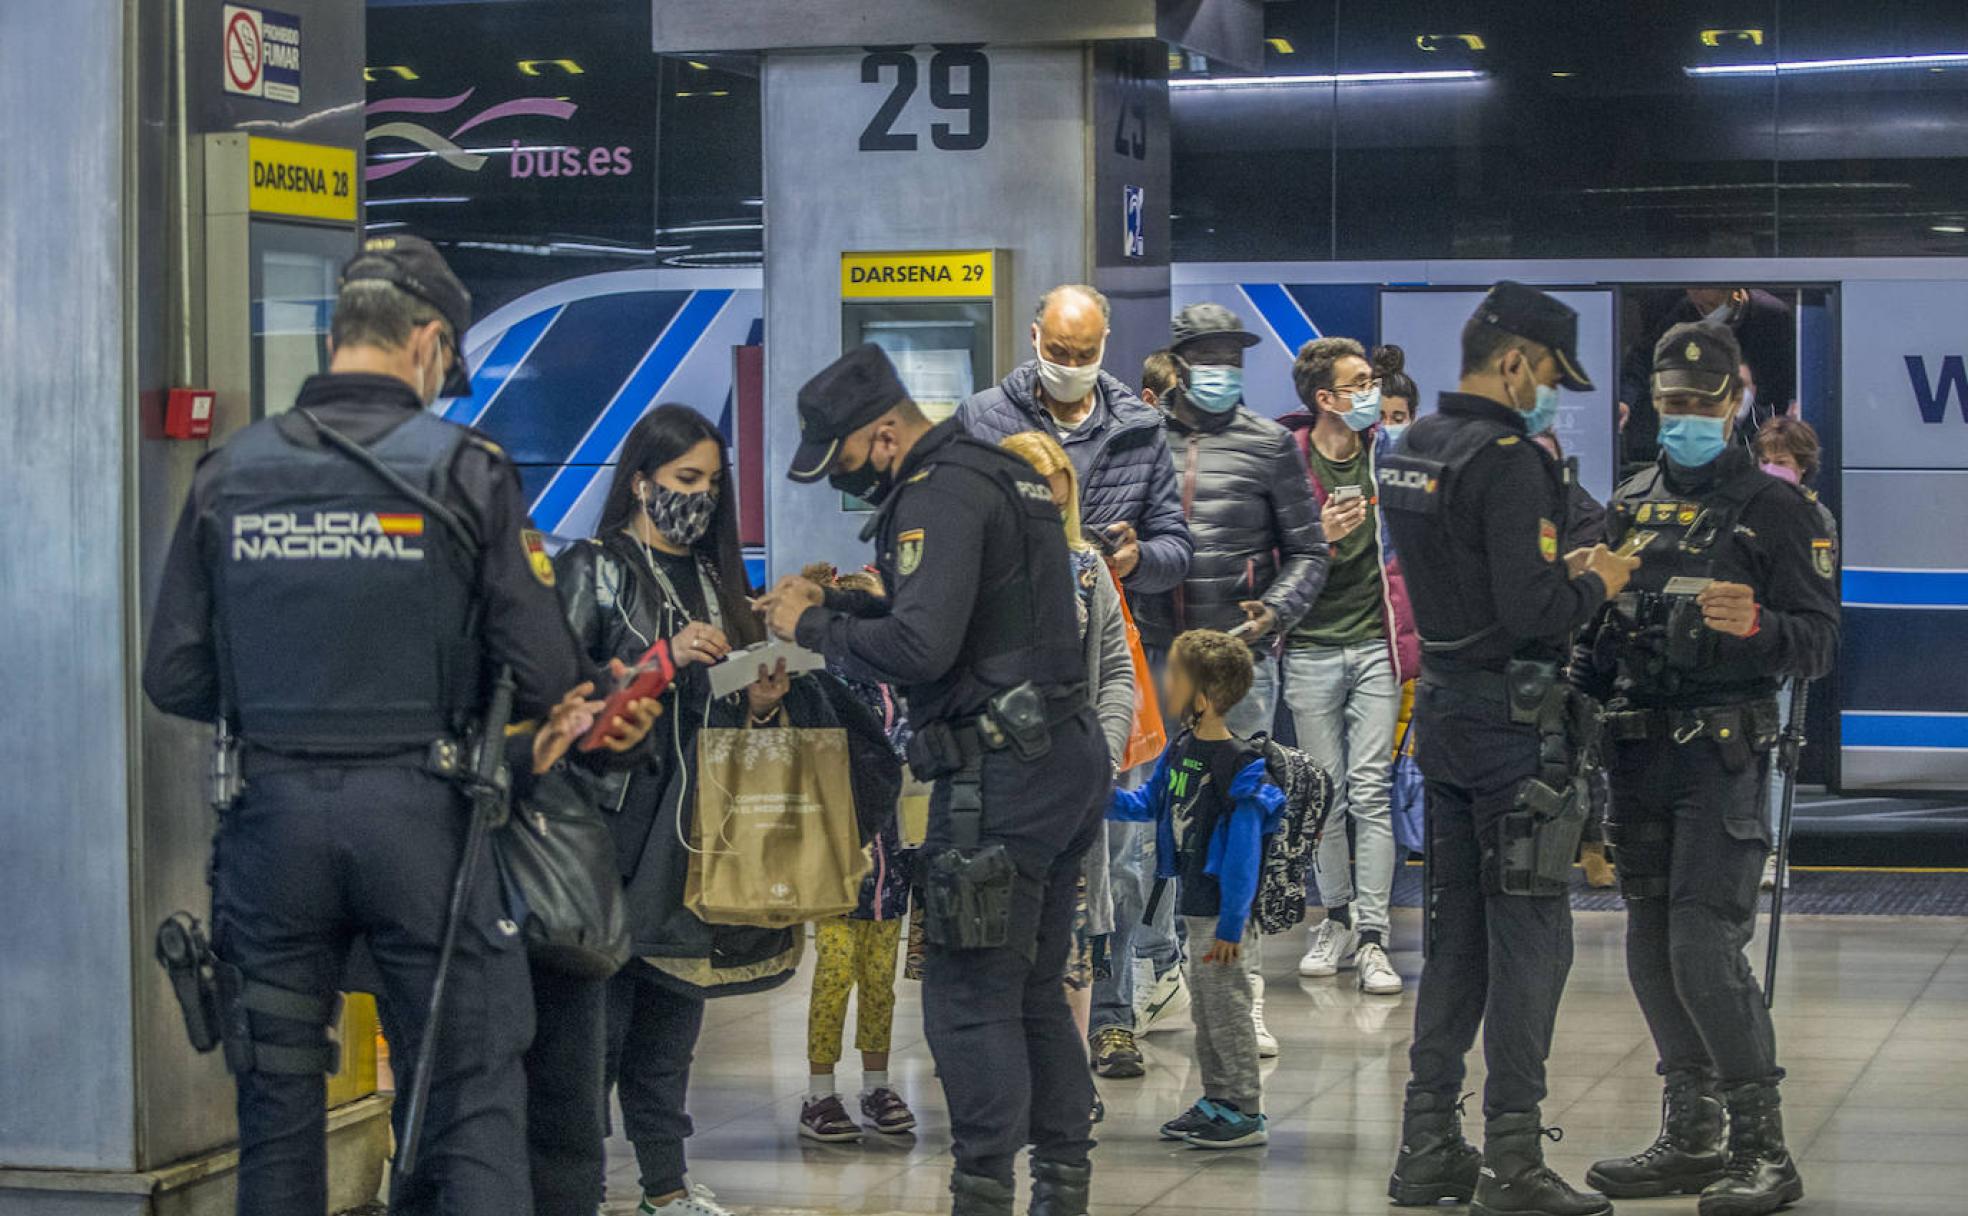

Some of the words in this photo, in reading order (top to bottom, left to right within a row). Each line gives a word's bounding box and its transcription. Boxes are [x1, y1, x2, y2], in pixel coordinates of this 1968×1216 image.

[263, 41, 300, 70] FUMAR
[858, 44, 989, 151] 29
[511, 140, 633, 178] bus.es
[254, 160, 328, 196] DARSENA
[332, 170, 349, 198] 28
[851, 265, 952, 283] DARSENA
[962, 264, 984, 282] 29
[233, 512, 383, 537] POLICIA
[233, 535, 425, 561] NACIONAL
